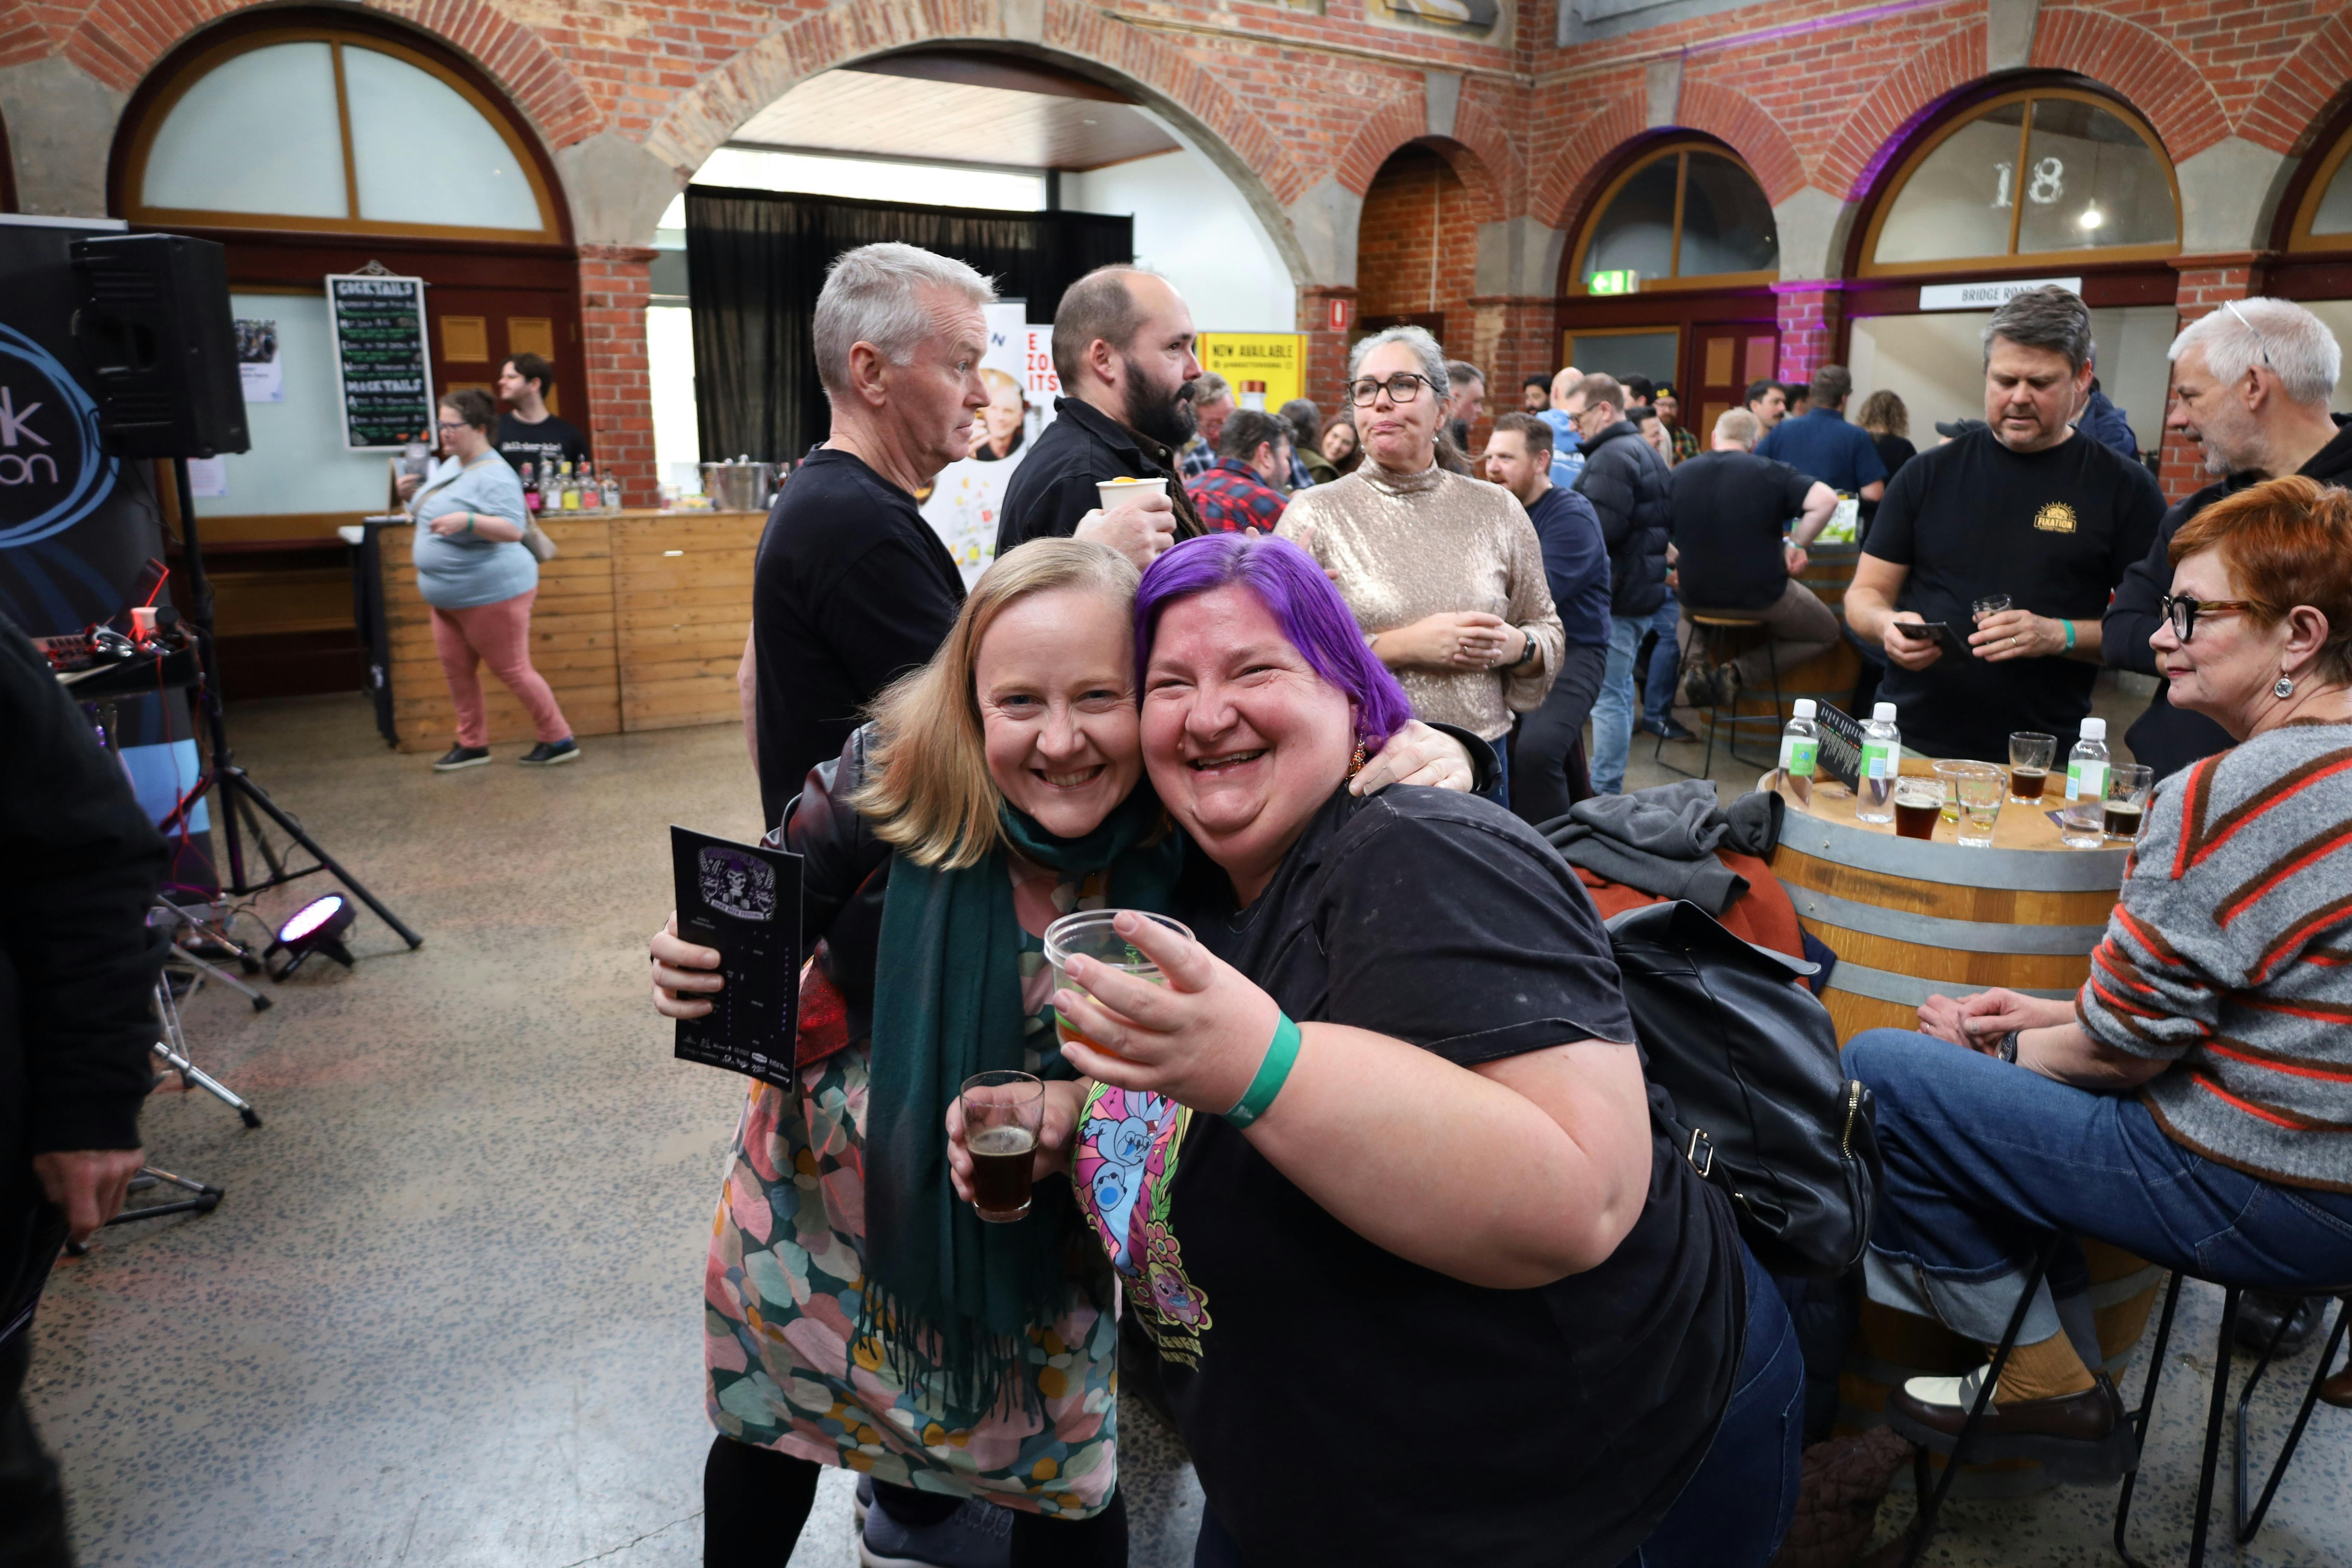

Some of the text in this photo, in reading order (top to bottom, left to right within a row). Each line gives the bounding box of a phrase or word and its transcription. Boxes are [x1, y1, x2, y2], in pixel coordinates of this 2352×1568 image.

[1990, 157, 2063, 207] 18
[337, 282, 414, 296] COCKTAILS
[1962, 288, 1999, 301] BRIDGE
[1029, 333, 1038, 350] E
[1213, 345, 1293, 358] NOW AVAILABLE
[1027, 353, 1057, 371] ZO
[346, 378, 423, 392] MOCKTAILS
[2037, 517, 2073, 530] FIXATION
